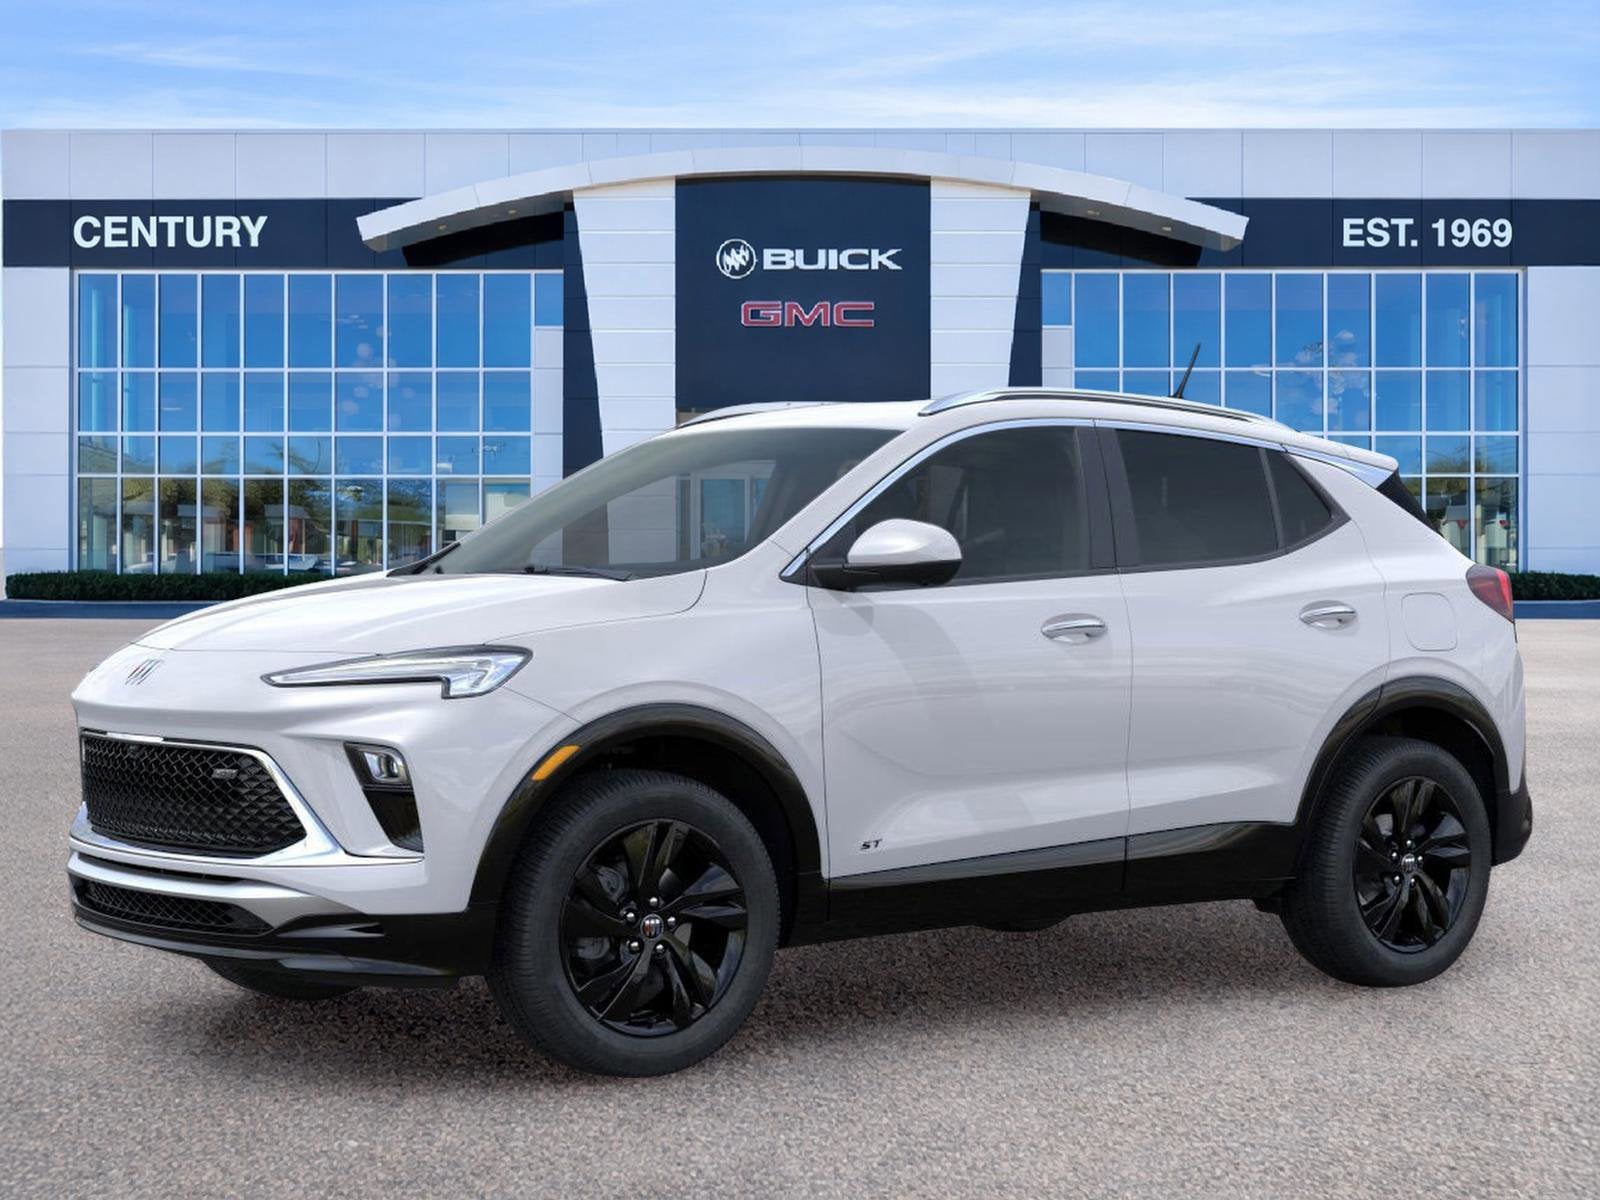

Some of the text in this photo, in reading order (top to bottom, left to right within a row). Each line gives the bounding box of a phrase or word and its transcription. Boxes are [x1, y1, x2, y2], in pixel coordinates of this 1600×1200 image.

[73, 215, 268, 248] CENTURY
[1342, 217, 1513, 248] EST. 1969
[762, 248, 902, 270] BUICK
[740, 300, 875, 327] GMC
[860, 838, 883, 850] ST
